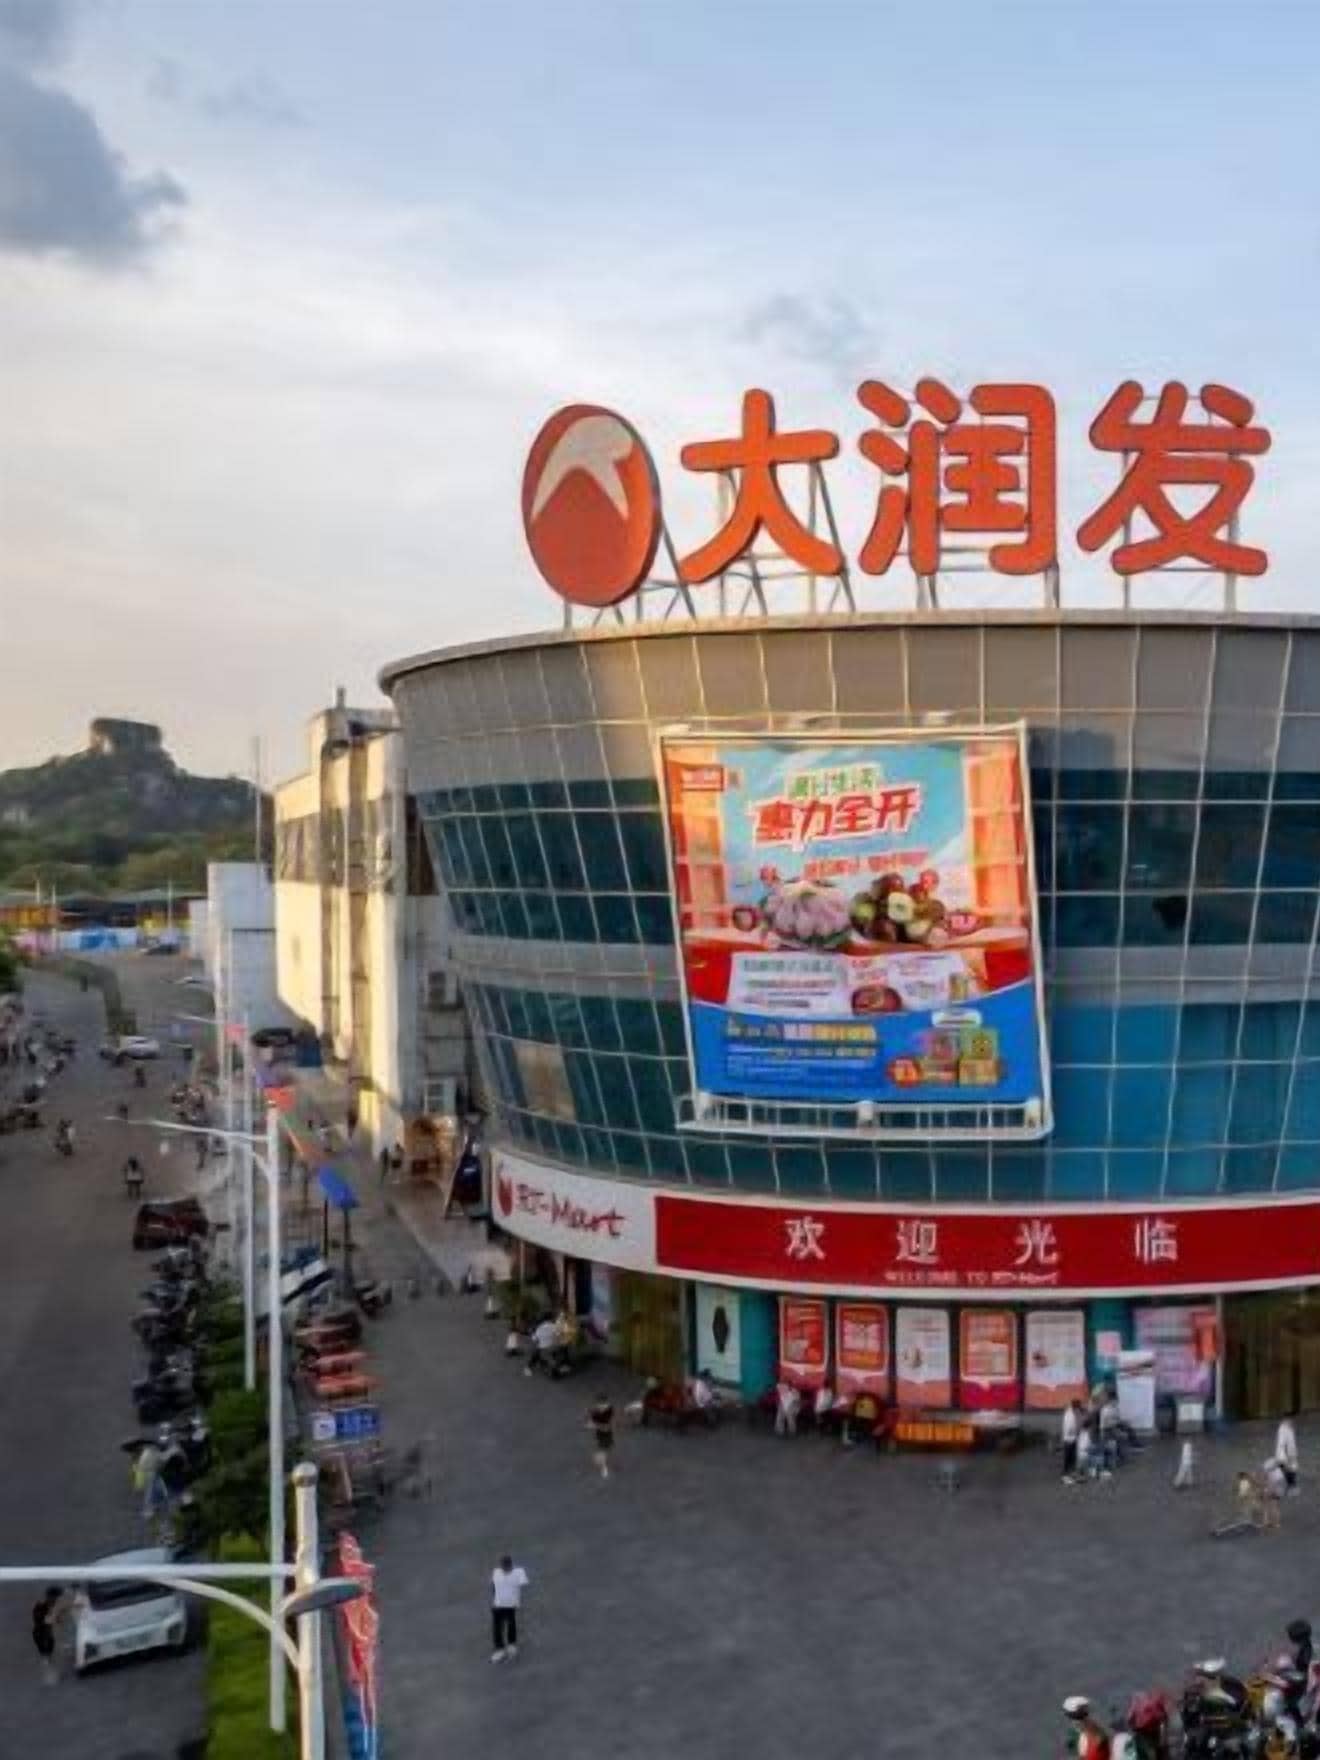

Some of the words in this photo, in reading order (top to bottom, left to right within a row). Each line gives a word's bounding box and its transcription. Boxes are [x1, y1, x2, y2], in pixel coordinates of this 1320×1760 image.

[680, 376, 1273, 584] 大润发
[784, 1215, 1179, 1266] 欢迎光临
